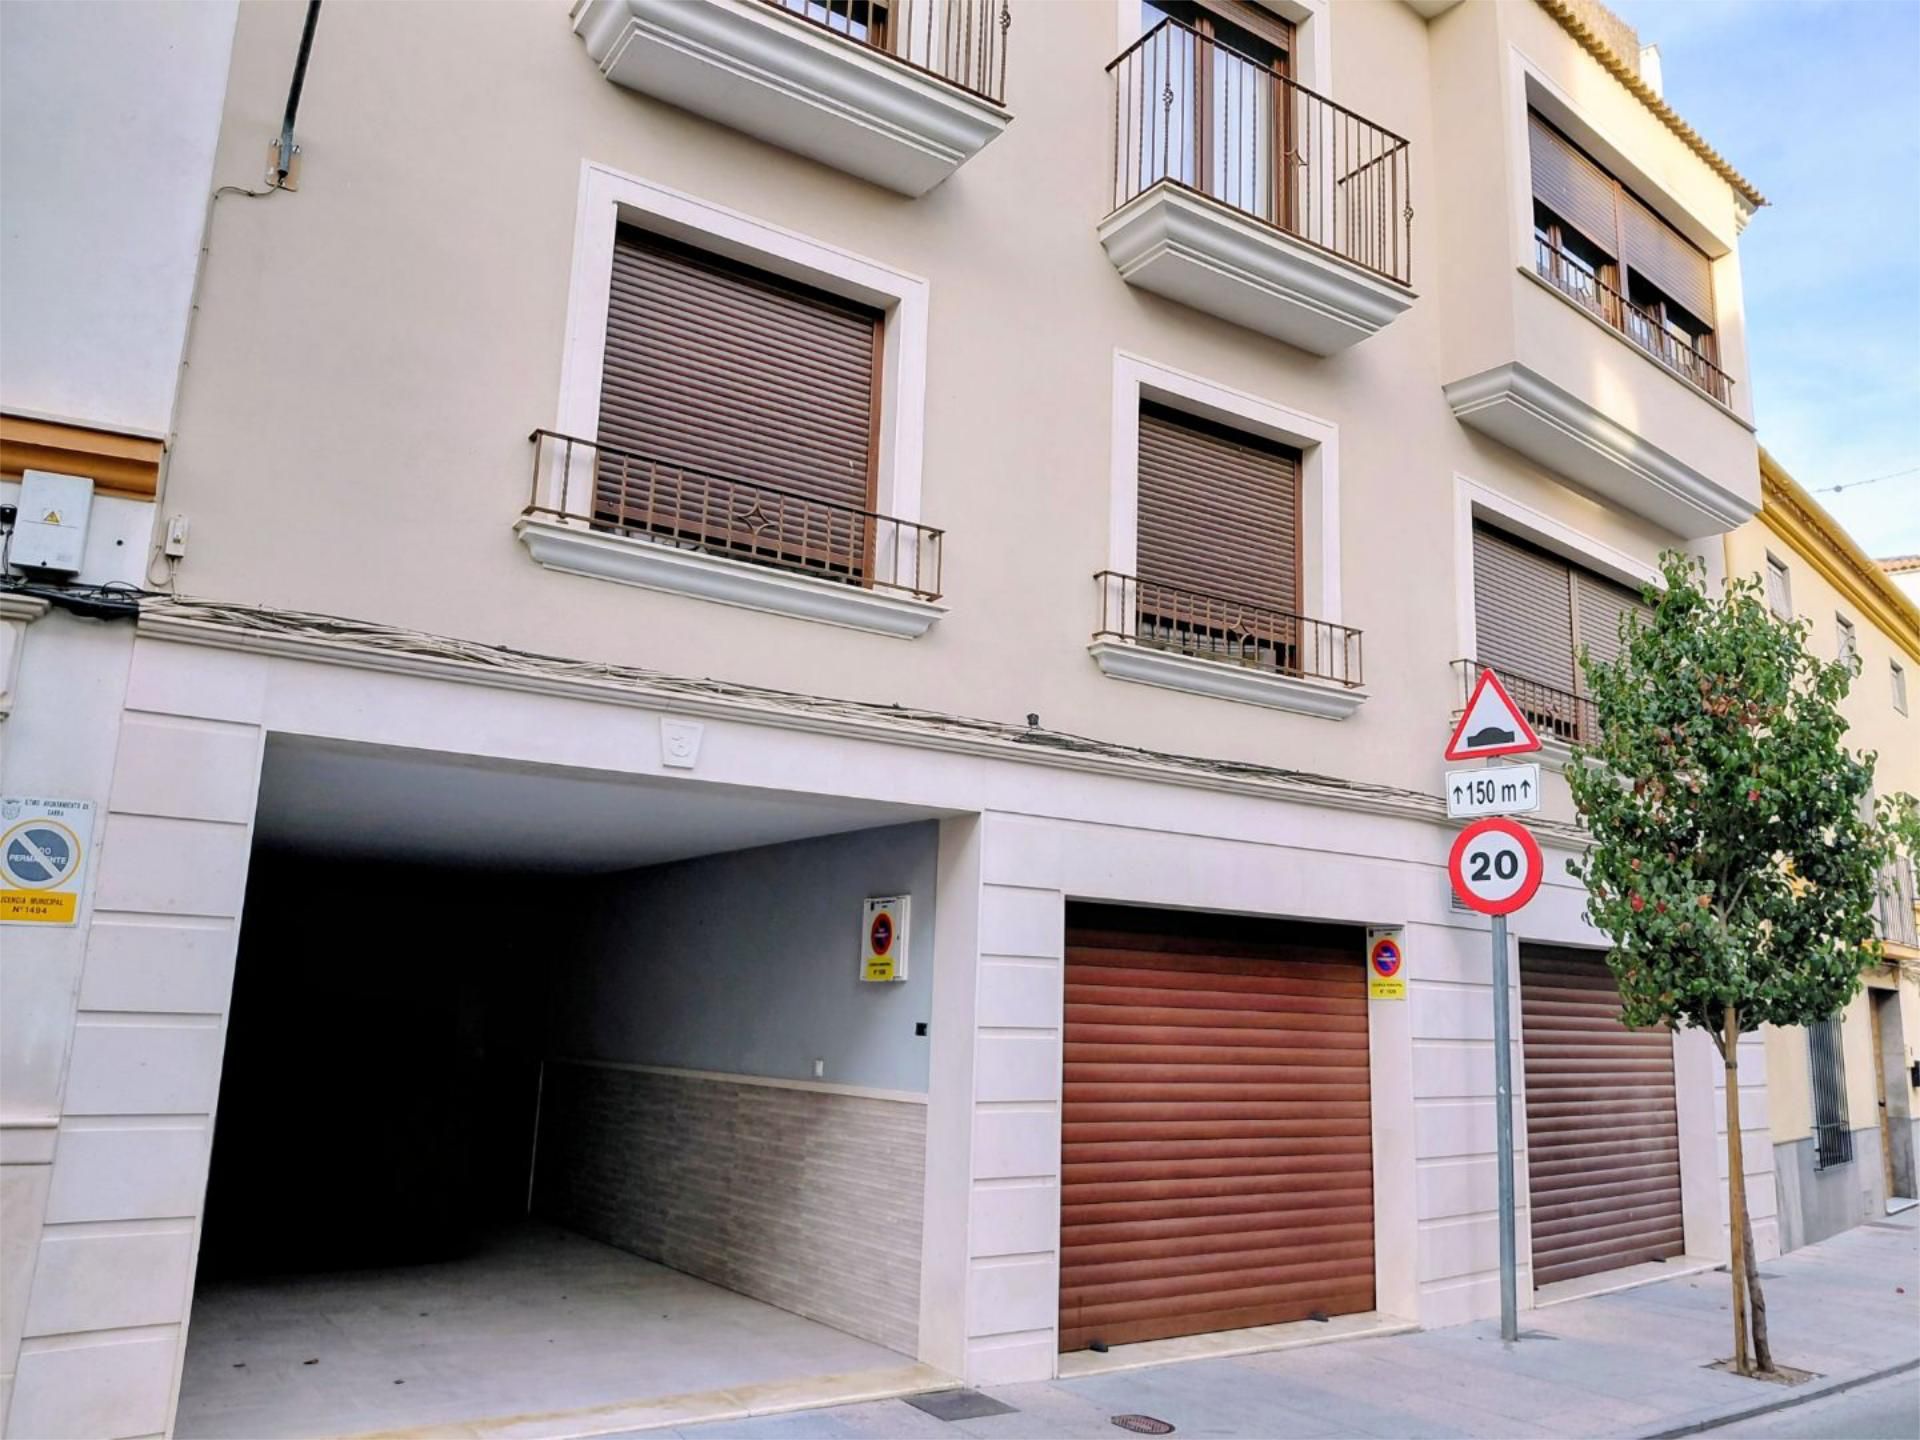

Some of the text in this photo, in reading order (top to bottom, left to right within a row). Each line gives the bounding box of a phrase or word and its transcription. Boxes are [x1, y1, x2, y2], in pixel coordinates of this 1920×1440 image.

[1466, 779, 1517, 805] 150 m
[1470, 850, 1518, 881] 20
[30, 896, 64, 906] MUNICIPAL
